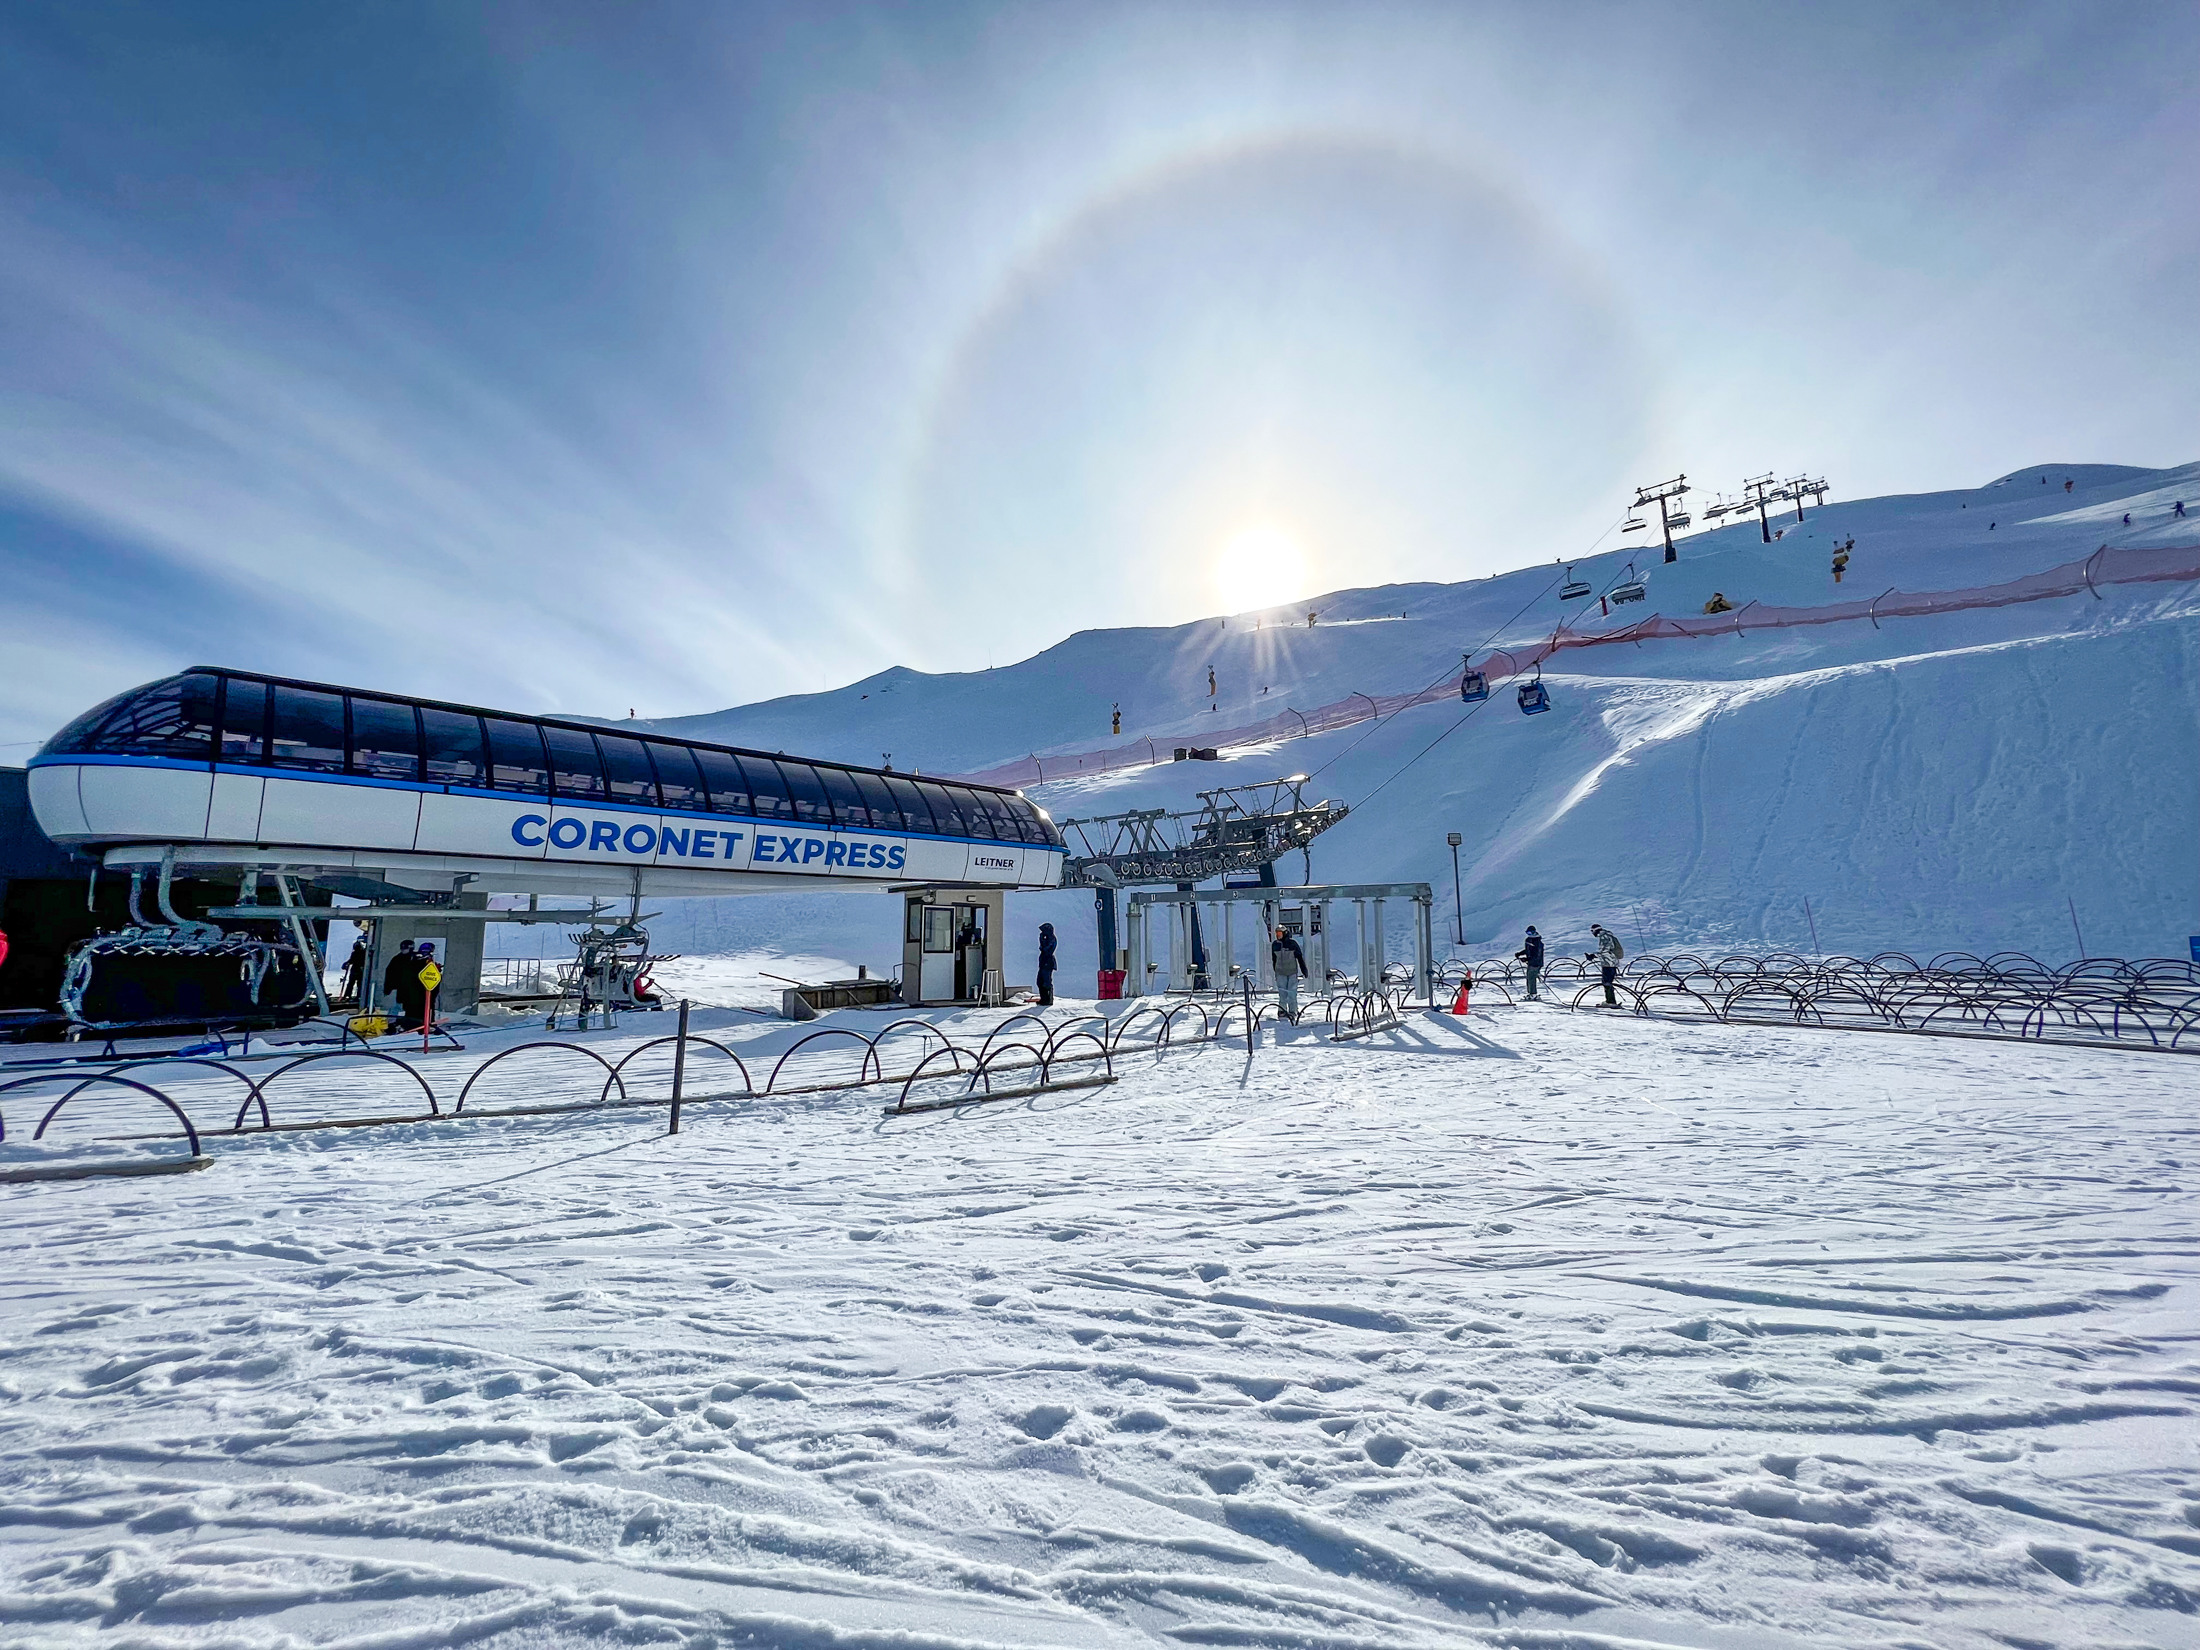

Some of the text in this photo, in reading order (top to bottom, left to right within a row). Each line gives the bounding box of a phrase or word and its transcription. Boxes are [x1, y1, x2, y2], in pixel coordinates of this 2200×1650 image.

[511, 814, 905, 870] CORONET EXPRESS
[974, 857, 1015, 868] LEITNER
